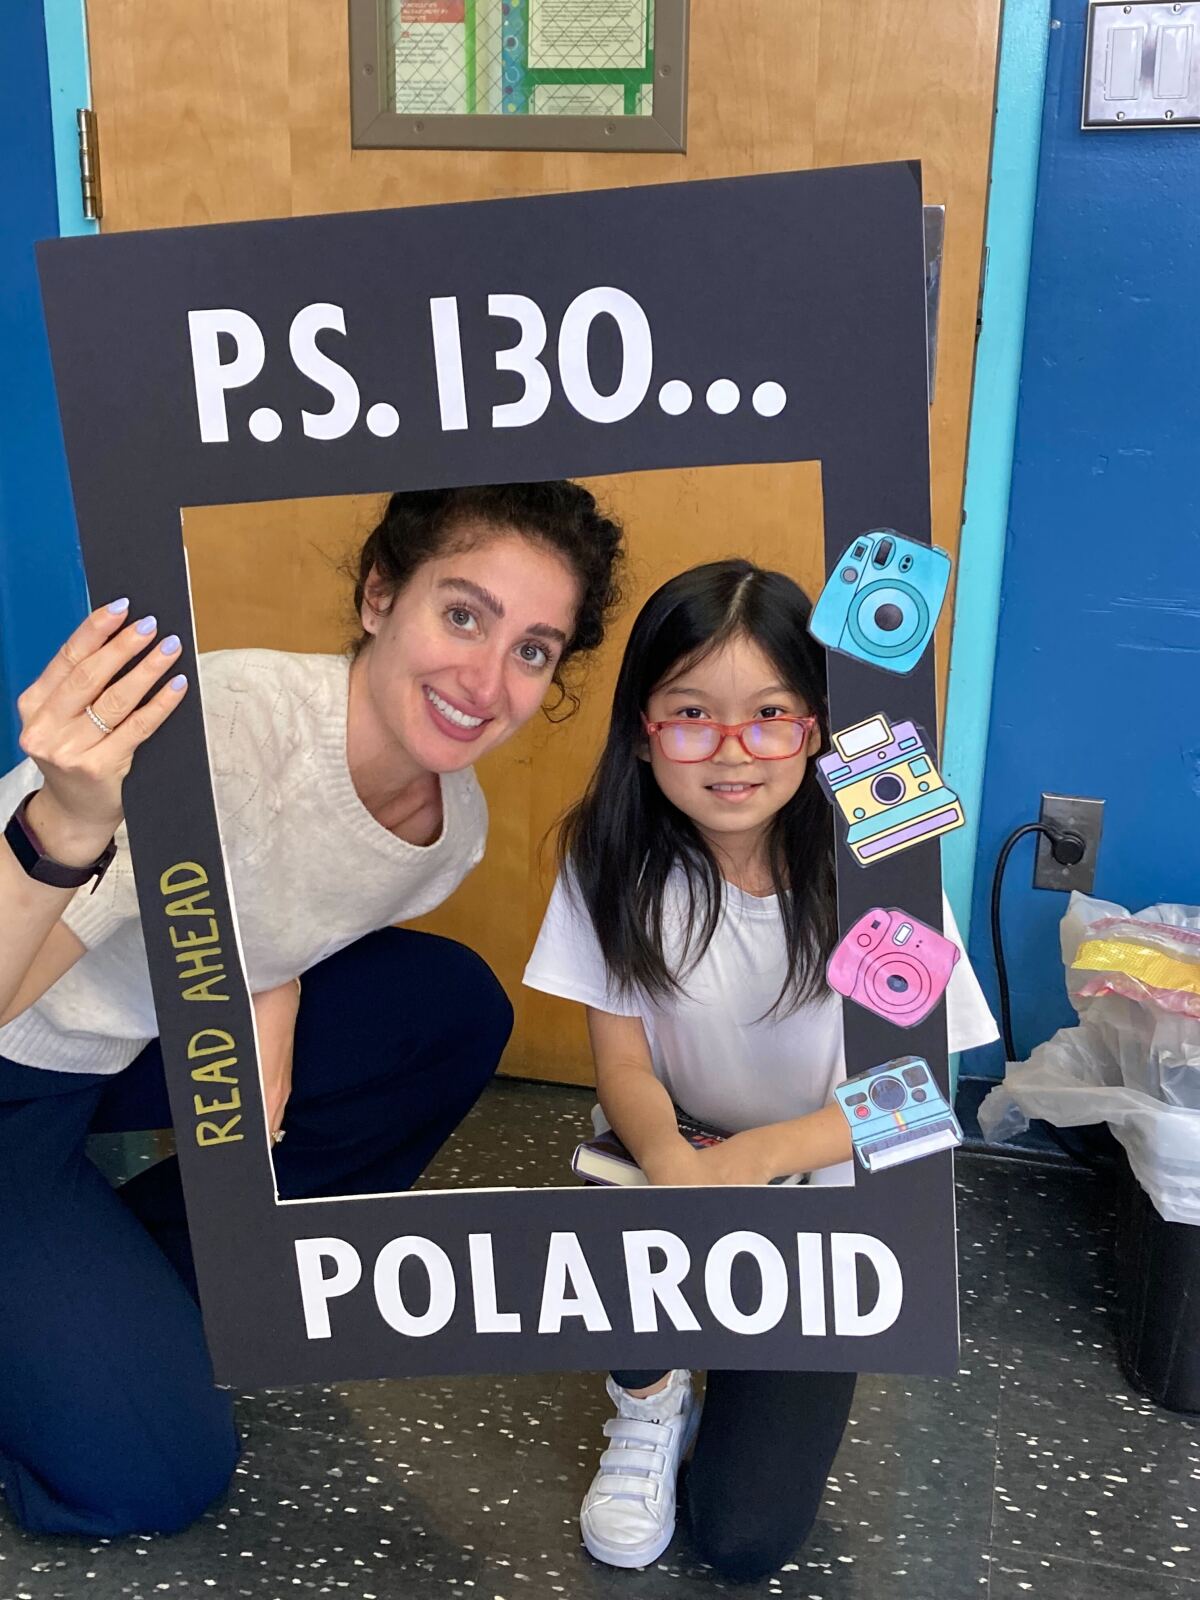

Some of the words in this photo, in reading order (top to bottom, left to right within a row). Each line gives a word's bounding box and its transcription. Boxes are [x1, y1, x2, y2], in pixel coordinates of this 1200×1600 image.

[188, 302, 400, 443] P.S.
[430, 286, 787, 431] 130...
[159, 861, 230, 1002] AHEAD
[187, 1028, 245, 1147] READ
[294, 1229, 904, 1340] POLAROID
